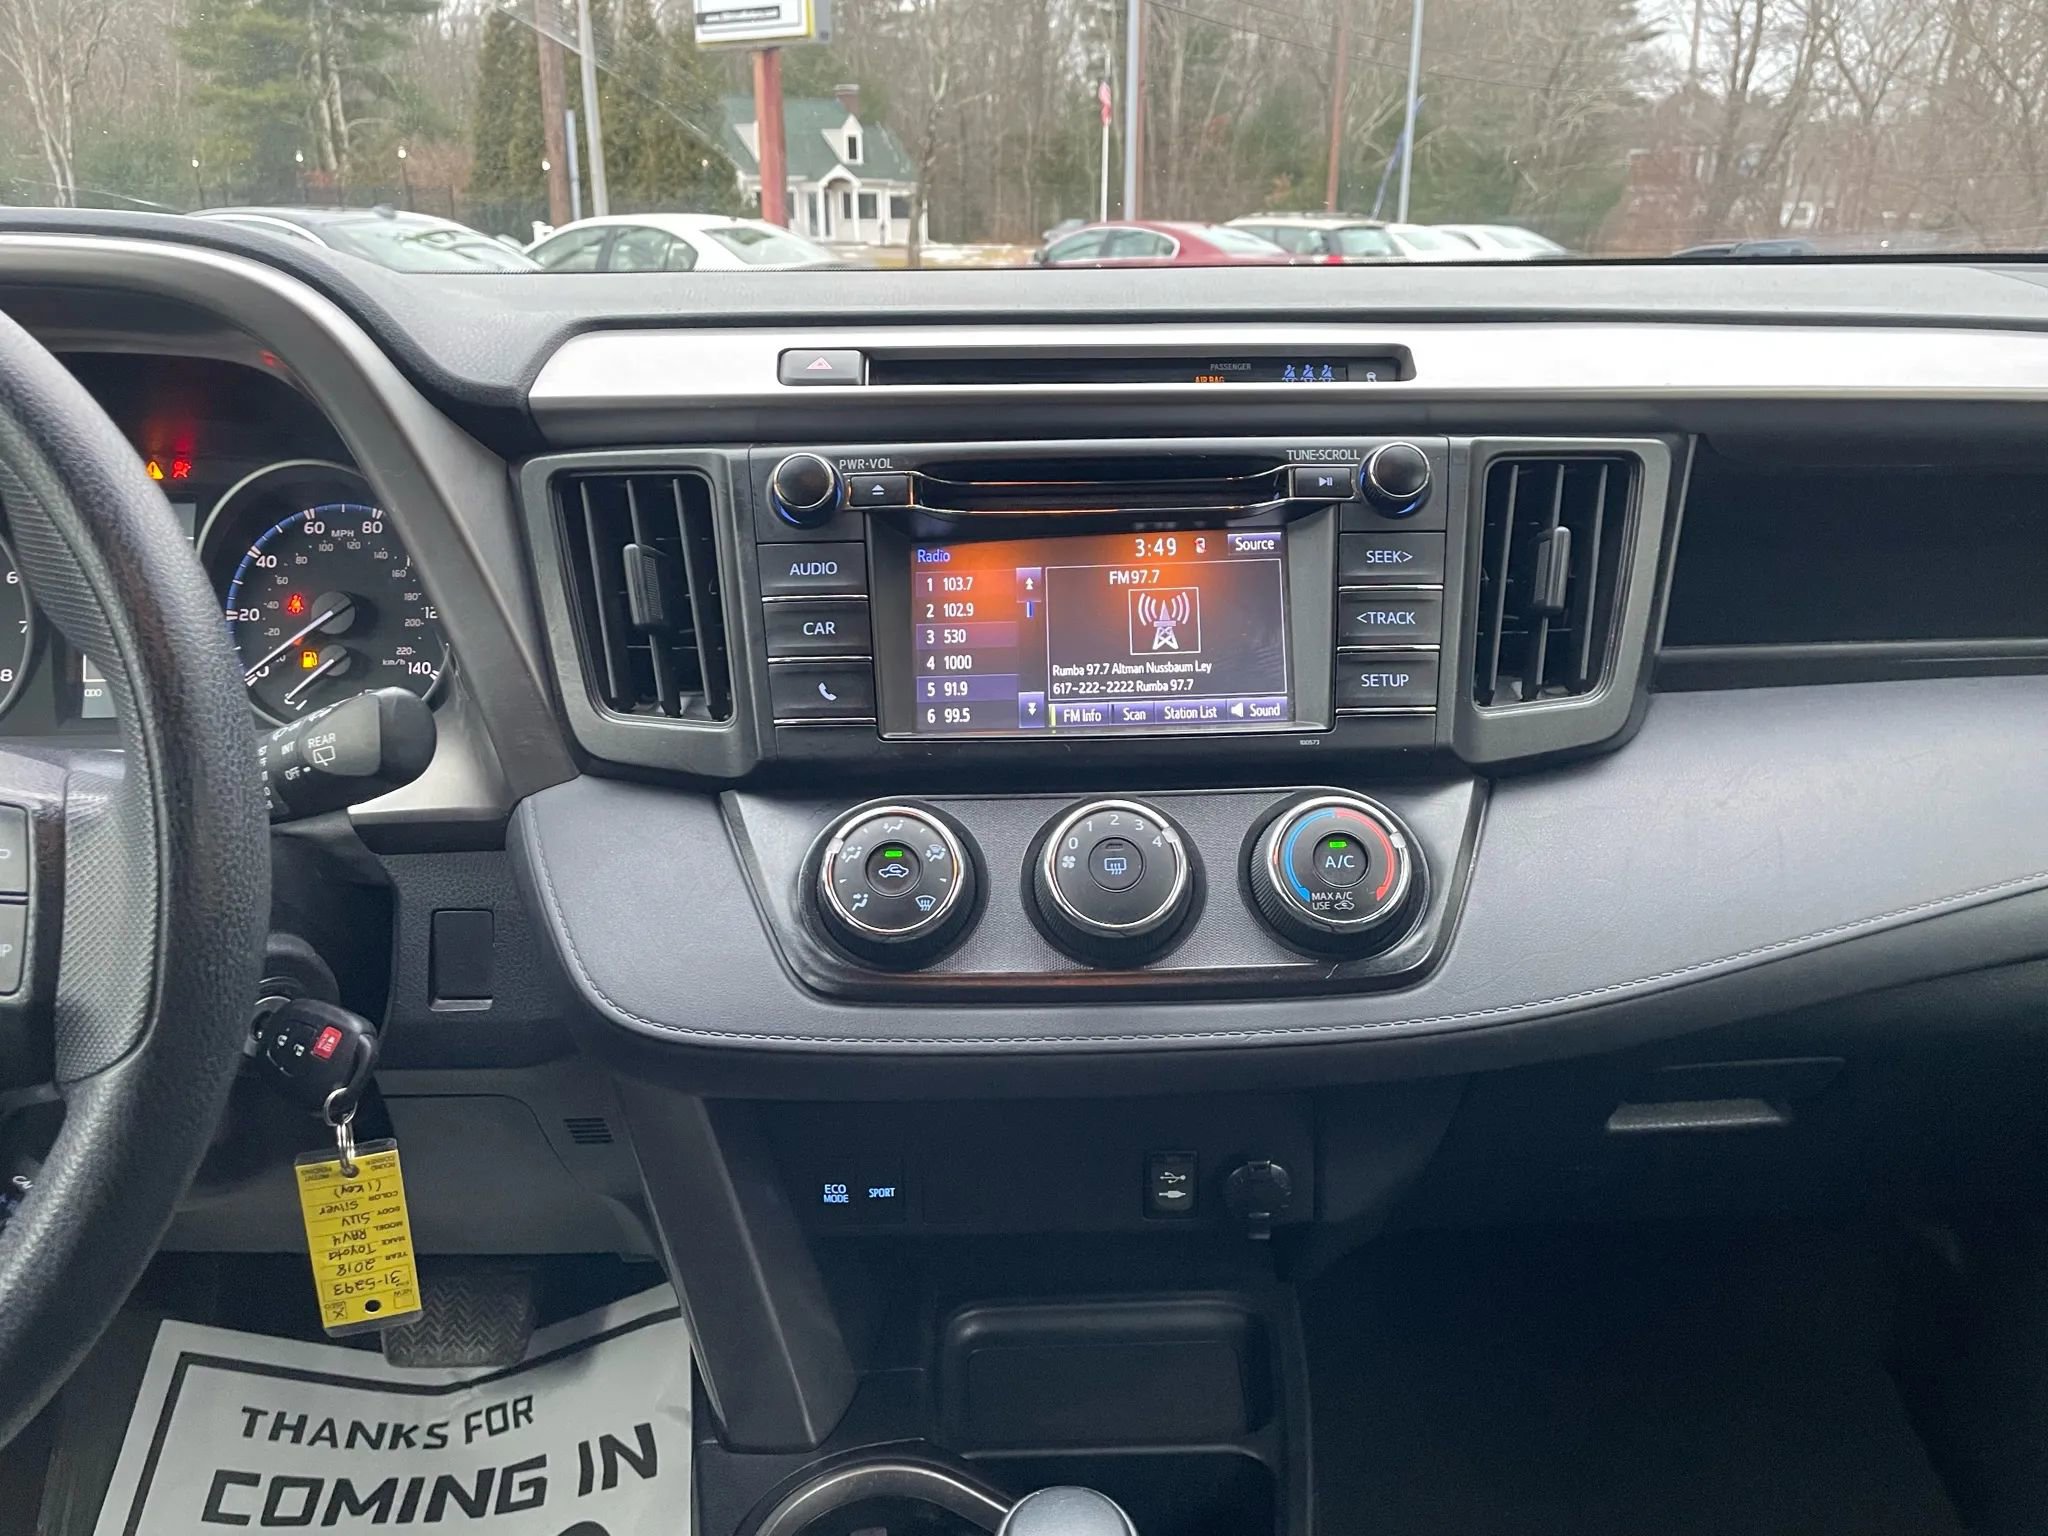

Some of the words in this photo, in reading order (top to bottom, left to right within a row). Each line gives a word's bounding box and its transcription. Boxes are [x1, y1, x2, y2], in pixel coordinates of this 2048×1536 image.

[1210, 363, 1251, 371] PASSENGER
[303, 521, 325, 535] 60
[331, 529, 354, 538] MPH
[362, 521, 383, 534] 80
[318, 543, 334, 552] 100
[346, 541, 361, 550] 120
[1135, 538, 1177, 557] 3:49
[1235, 537, 1275, 552] Source
[255, 555, 277, 569] 40
[295, 555, 308, 565] 80
[373, 551, 388, 560] 140
[918, 549, 950, 563] Radio
[789, 561, 838, 576] AUDIO
[6, 571, 18, 584] 6
[276, 576, 289, 585] 60
[927, 578, 933, 591] 1
[943, 577, 973, 591] 103.7
[239, 609, 260, 621] 20
[926, 604, 934, 618] 2
[943, 603, 974, 618] 102.9
[404, 619, 421, 627] 200
[803, 621, 836, 635] CAR
[926, 630, 935, 644] 3
[943, 629, 967, 643] 530
[396, 647, 412, 655] 220
[408, 661, 432, 675] 140
[926, 656, 935, 670] 4
[944, 656, 972, 670] 1000
[1053, 664, 1085, 677] Rumba
[1086, 663, 1109, 676] 97.7
[1112, 662, 1144, 675] Altman
[1146, 661, 1194, 674] Nussbaum
[1195, 661, 1212, 676] Ley
[0, 668, 12, 682] 8
[1361, 674, 1409, 688] SETUP
[927, 683, 935, 696] 5
[944, 682, 968, 696] 91.9
[1053, 680, 1134, 695] 617-222-2222
[1136, 680, 1168, 693] Rumba
[1170, 679, 1194, 692] 97.7
[927, 709, 936, 723] 6
[944, 708, 970, 723] 99.5
[1064, 711, 1081, 723] FM
[1082, 709, 1102, 722] Info
[1123, 708, 1146, 721] Scan
[1164, 706, 1197, 720] Station
[1199, 706, 1217, 719] List
[1250, 703, 1280, 718] Sound
[308, 733, 336, 748] REAR
[284, 766, 300, 780] OFF
[1086, 820, 1093, 832] 1
[1110, 814, 1120, 826] 2
[1135, 819, 1144, 831] 3
[1068, 837, 1078, 849] 0
[1152, 835, 1162, 847] 4
[1325, 855, 1356, 868] A/C
[1311, 892, 1334, 900] MAX
[1335, 891, 1353, 901] A/C
[1312, 902, 1330, 910] USE
[369, 1190, 398, 1202] COLOR
[824, 1184, 847, 1194] ECO
[868, 1187, 895, 1198] SPORT
[823, 1194, 849, 1203] MODE
[377, 1205, 400, 1216] BODY
[341, 1211, 370, 1227] SUV
[374, 1220, 403, 1231] MODEL
[333, 1229, 367, 1246] RAV4
[329, 1244, 376, 1260] Toyota
[385, 1252, 408, 1262] YEAR
[336, 1258, 376, 1276] 2018
[333, 1270, 400, 1296] 31-5293
[393, 1288, 412, 1297] NEW
[241, 1406, 449, 1451] THANKS
[464, 1395, 535, 1445] FOR
[201, 1453, 548, 1526] COMING
[576, 1421, 659, 1498] IN
